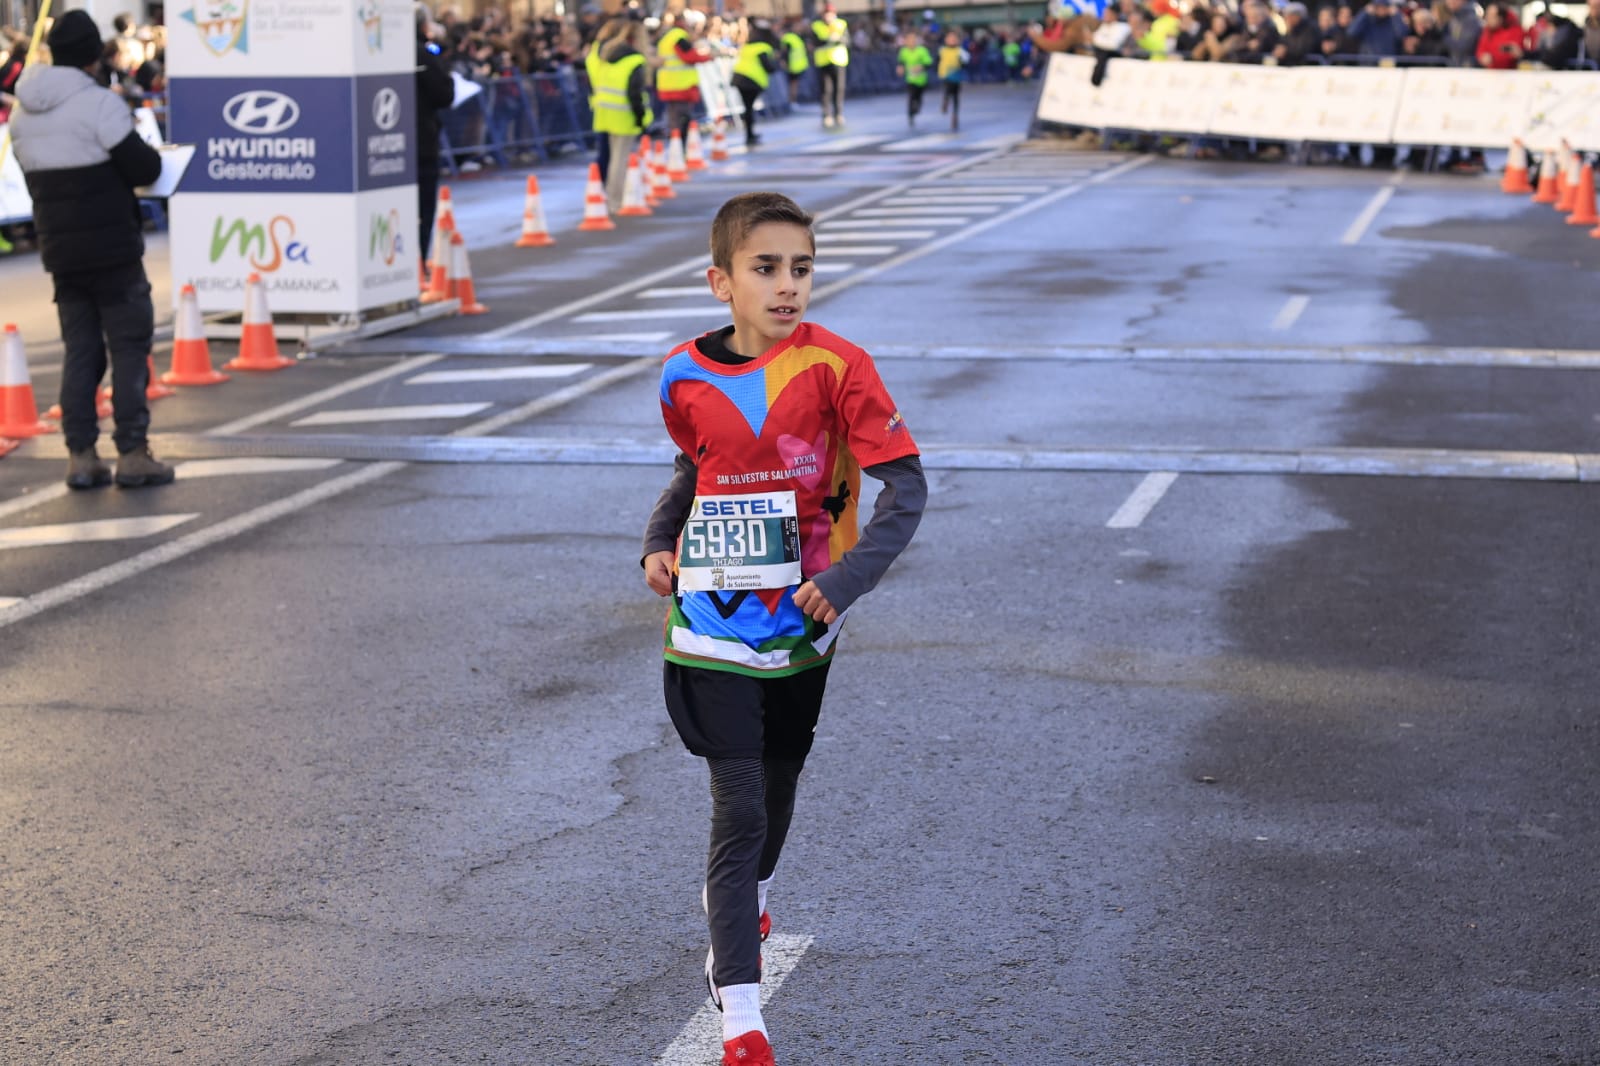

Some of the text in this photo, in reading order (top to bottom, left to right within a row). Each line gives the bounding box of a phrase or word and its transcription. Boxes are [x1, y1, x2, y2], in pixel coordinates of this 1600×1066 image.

[207, 138, 316, 158] HYUNDAI
[207, 159, 316, 180] Gestorauto
[187, 277, 340, 293] MERCALAMANCA
[793, 453, 817, 466] XXXIX
[716, 464, 818, 485] SAN SILVESTRE SALMANTINA
[702, 499, 783, 516] SETEL
[687, 519, 768, 559] 5930
[712, 558, 744, 567] THIAGO
[734, 580, 762, 588] Salamanca
